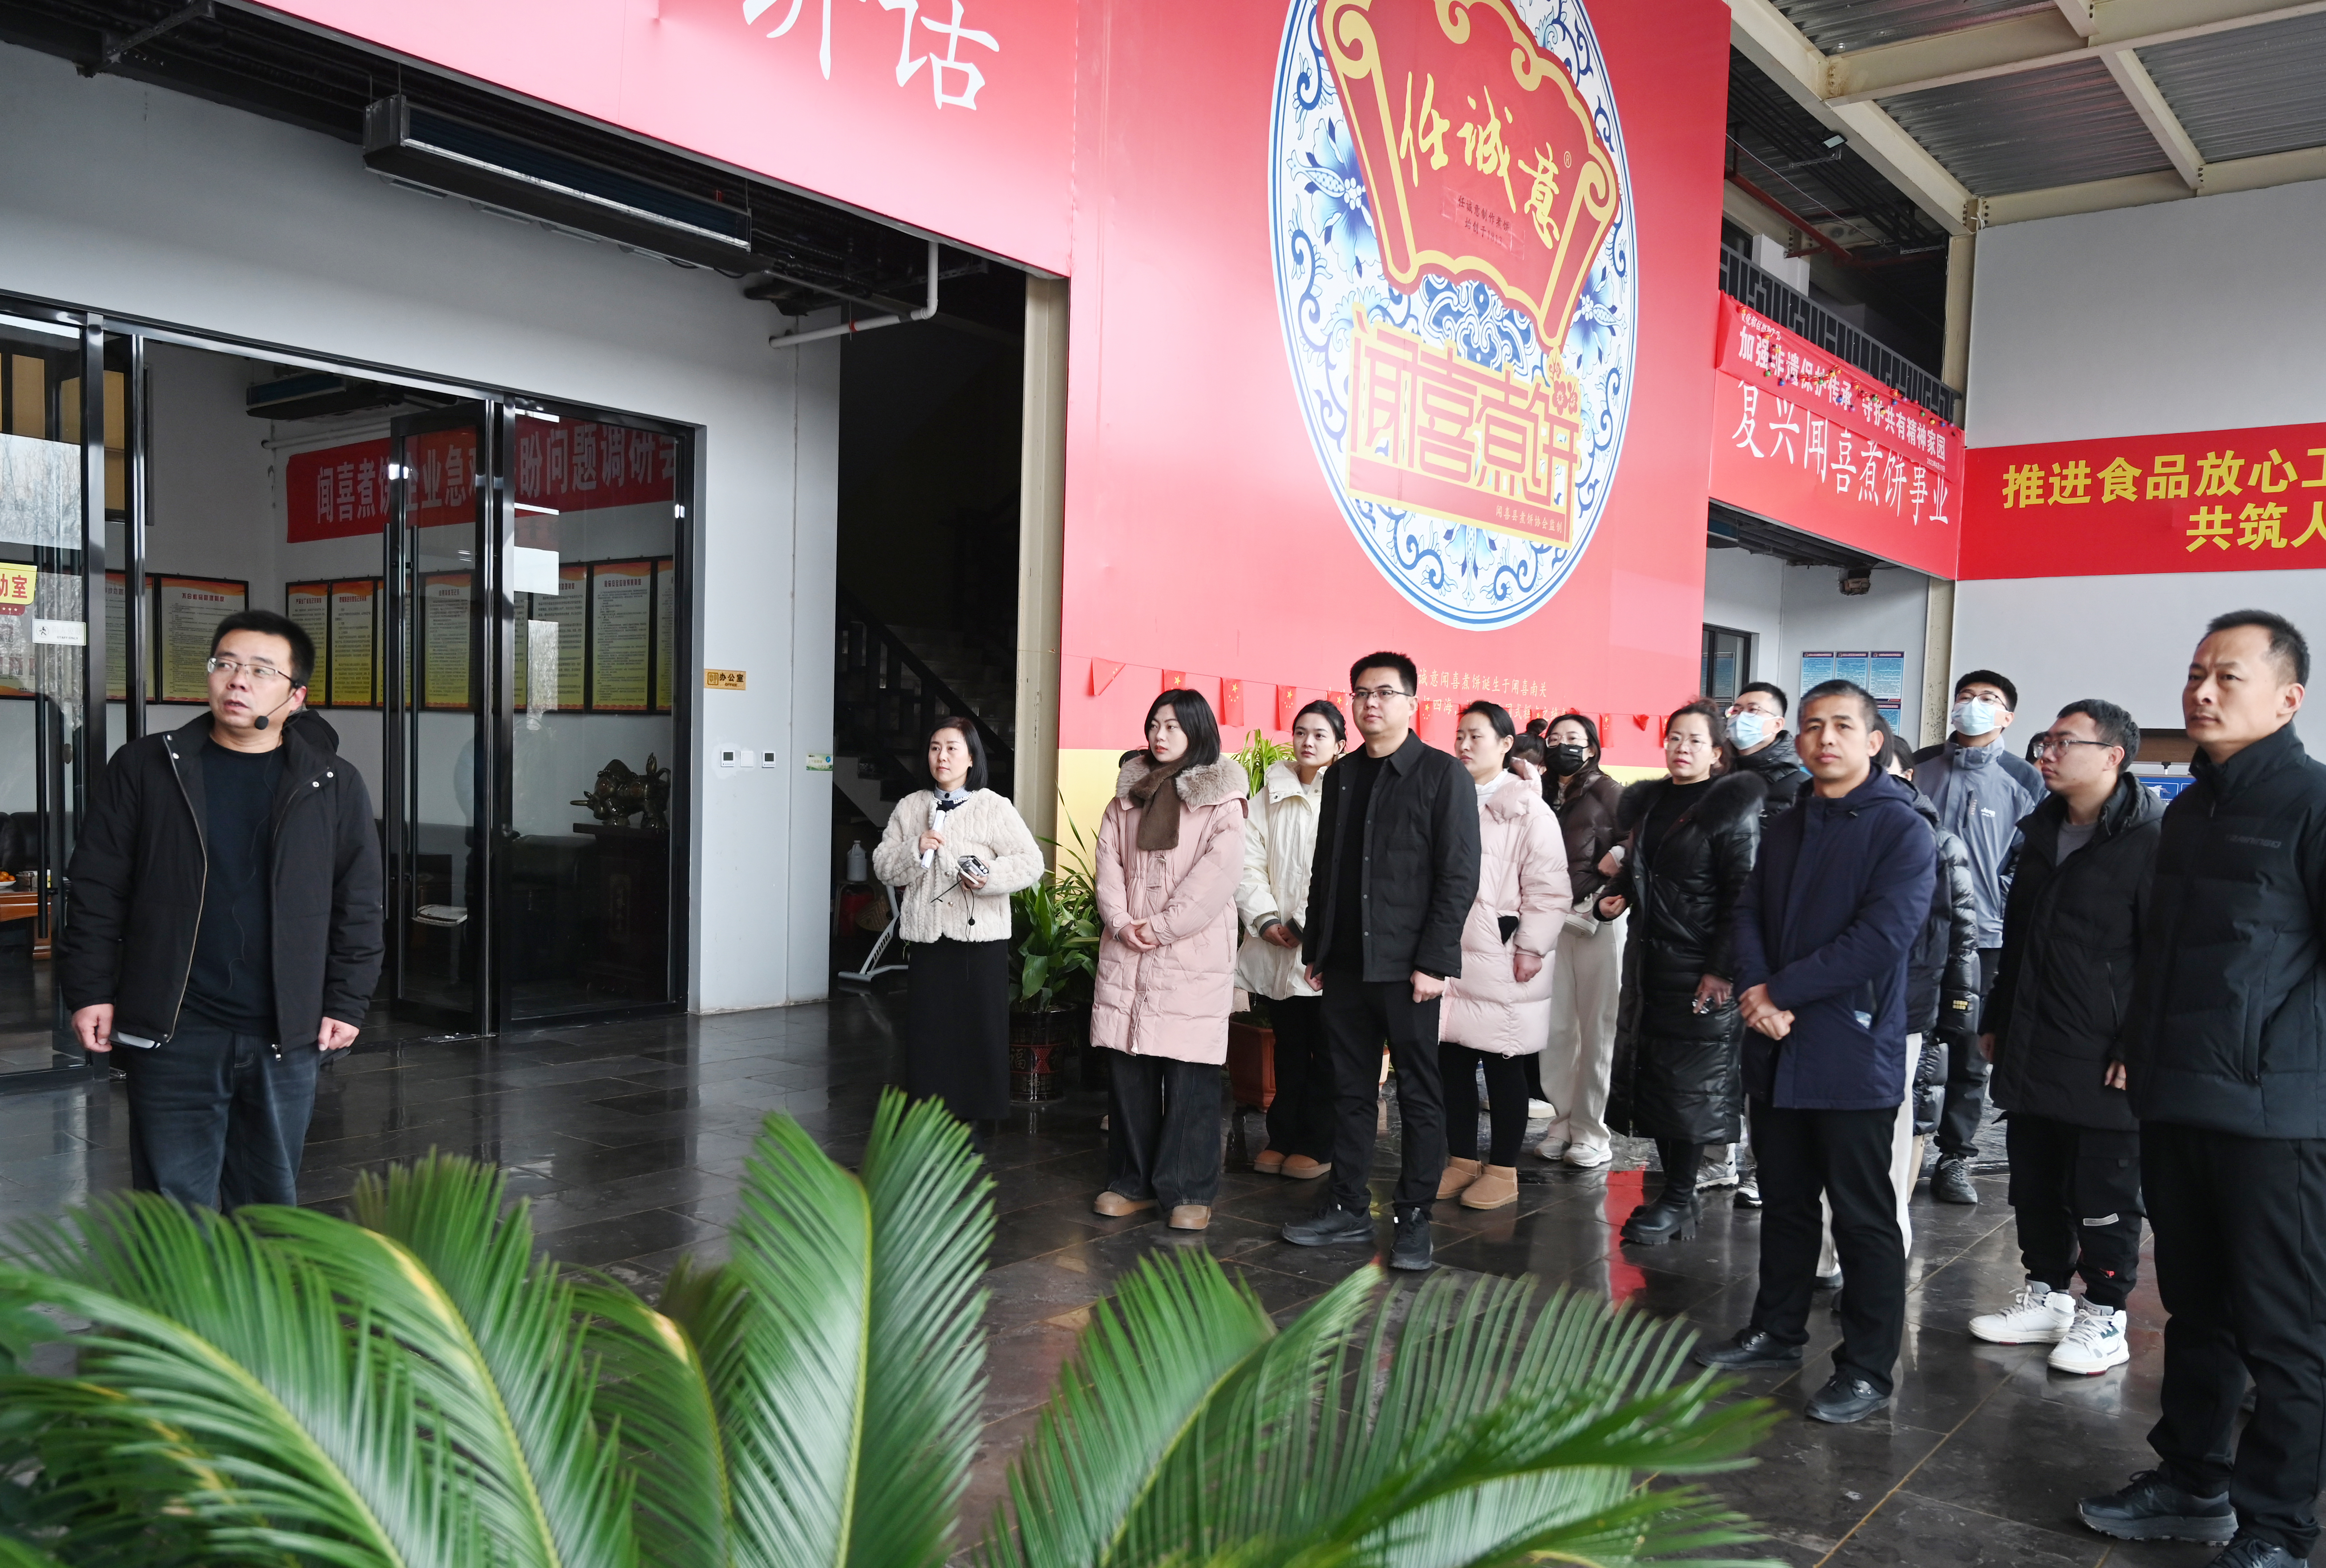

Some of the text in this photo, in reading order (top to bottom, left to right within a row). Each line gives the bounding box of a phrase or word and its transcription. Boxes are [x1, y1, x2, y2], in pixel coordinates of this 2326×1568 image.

[1399, 71, 1560, 250] 任诚意
[1458, 195, 1510, 233] 任诚意制作煮饼
[1465, 217, 1503, 246] 始创于1813
[1731, 380, 1949, 526] 复兴闻喜煮饼事业
[1496, 505, 1562, 533] 闻喜县煮饼协会监制
[2186, 501, 2326, 553] 共筑人
[719, 673, 744, 683] 办公室
